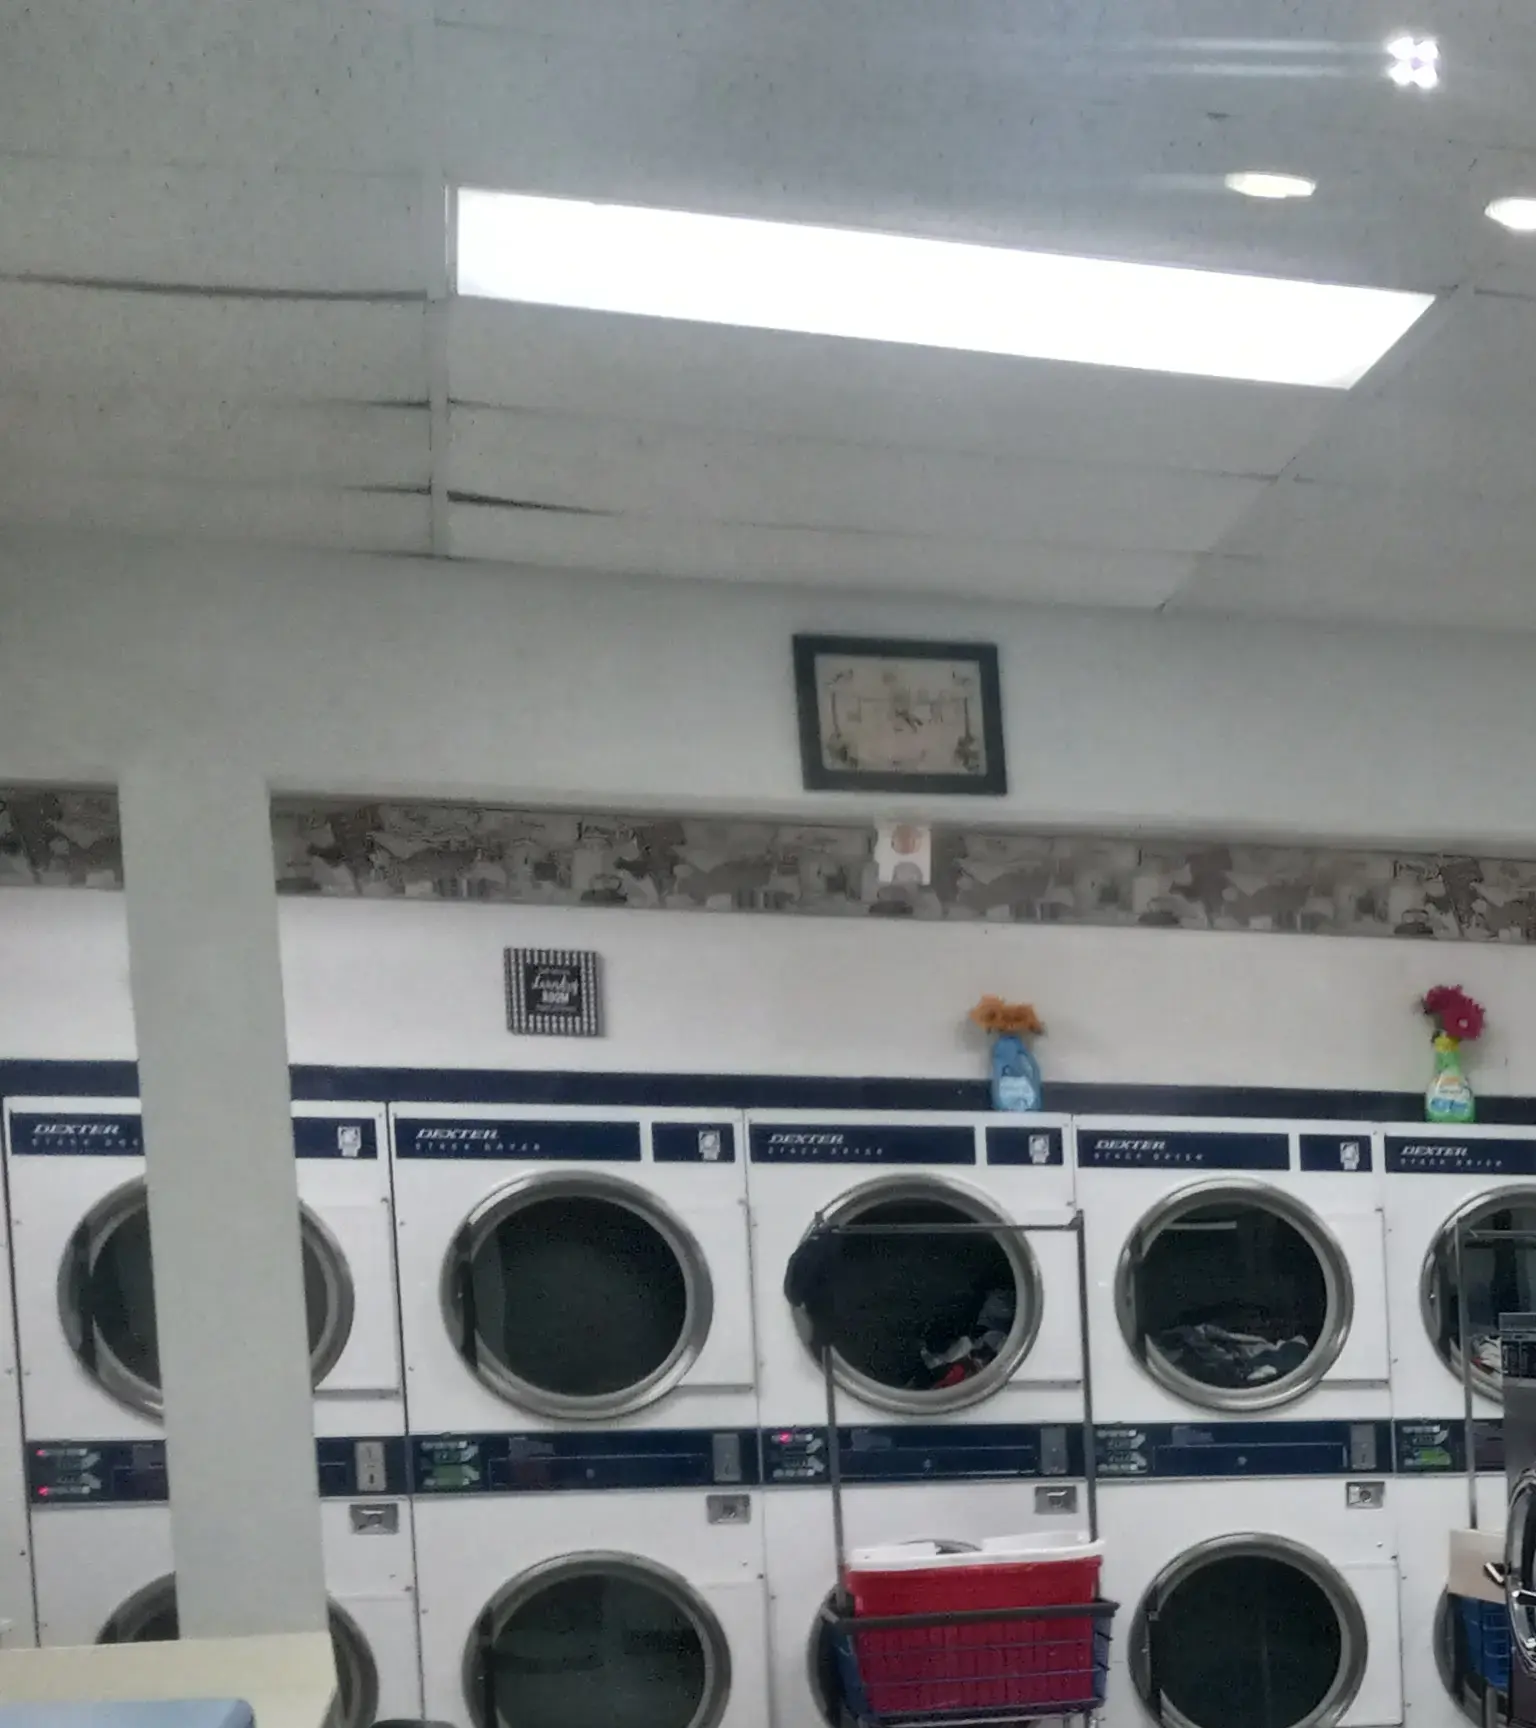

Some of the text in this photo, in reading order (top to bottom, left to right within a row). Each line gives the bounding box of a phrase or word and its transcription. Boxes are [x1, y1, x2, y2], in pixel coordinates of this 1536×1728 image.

[33, 1123, 120, 1135] DEXTER
[415, 1128, 500, 1140] DEXTER
[768, 1133, 845, 1145] DEXTER
[1093, 1139, 1165, 1151] DEXTER
[1400, 1145, 1469, 1157] DEXTER
